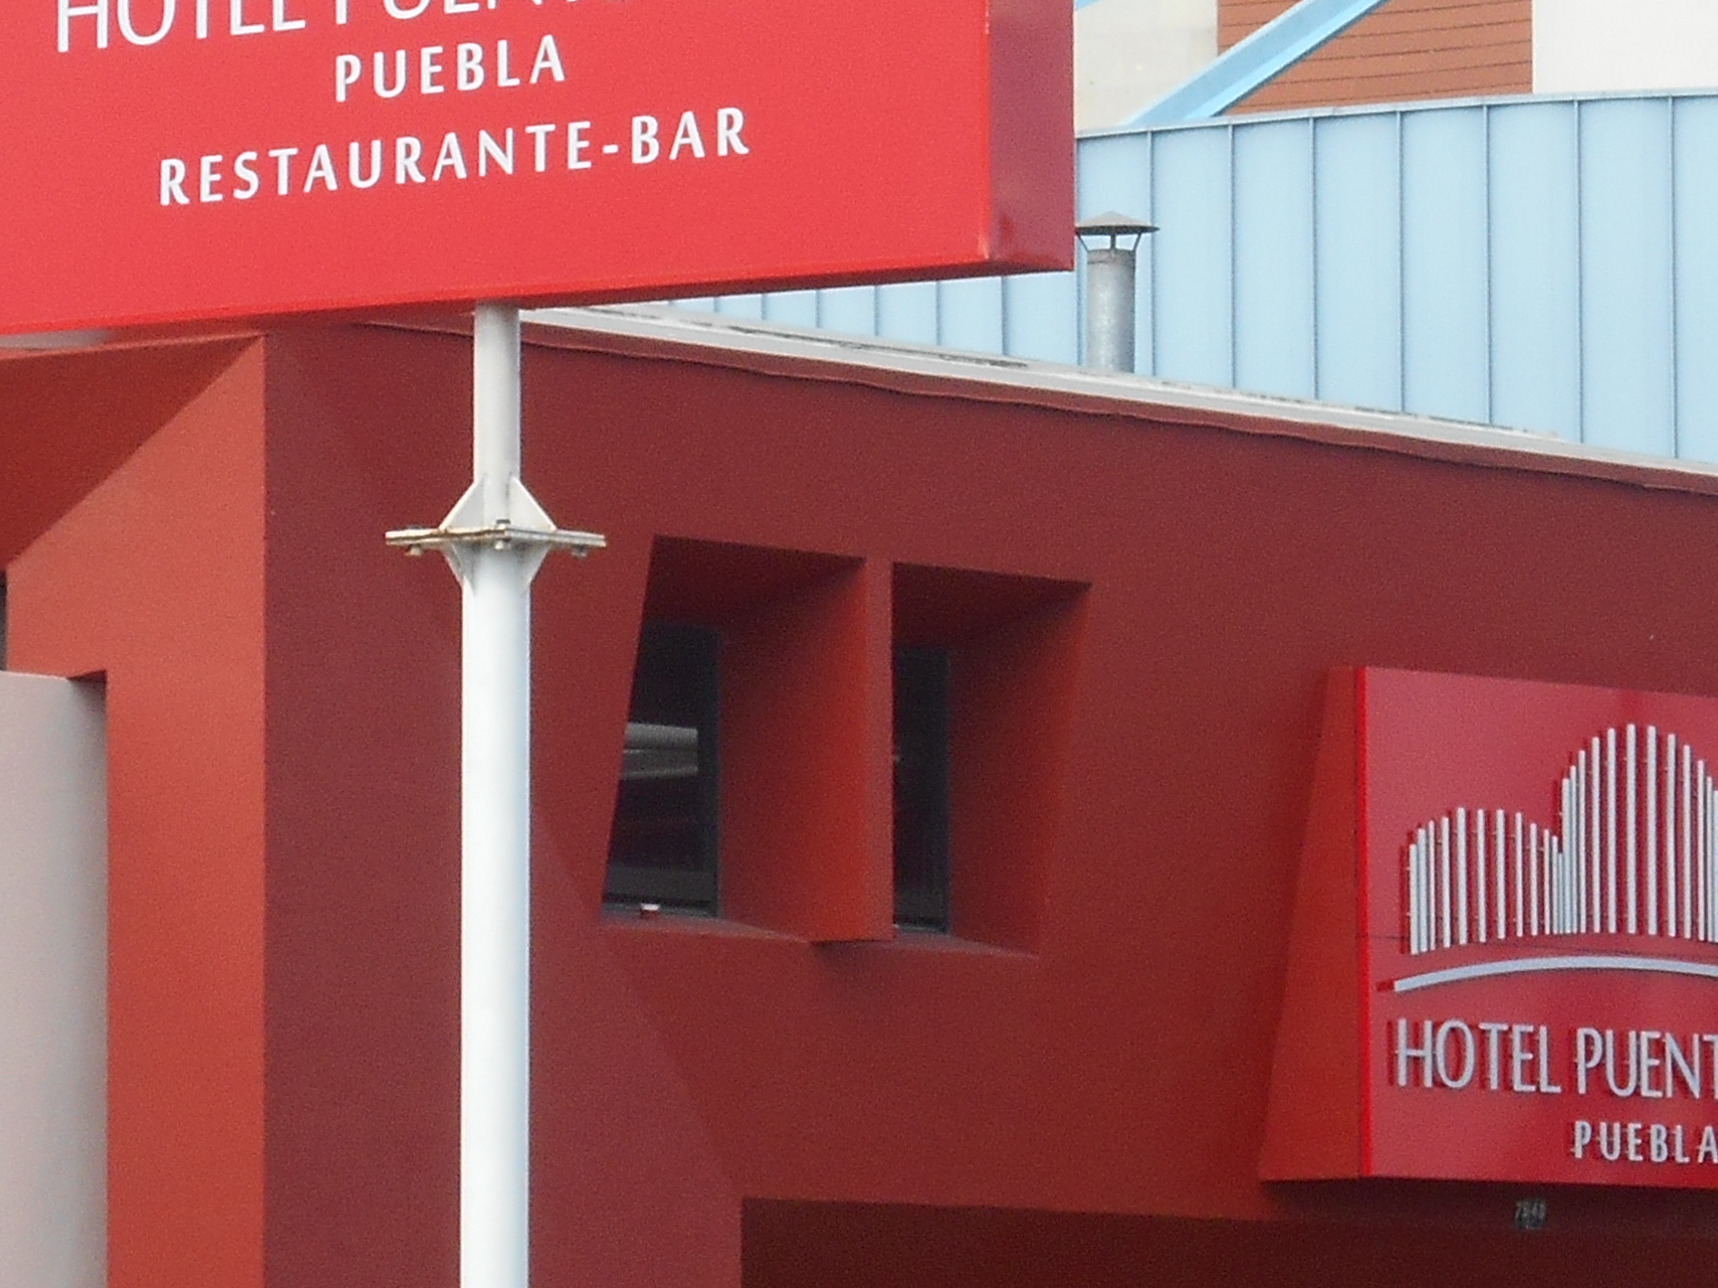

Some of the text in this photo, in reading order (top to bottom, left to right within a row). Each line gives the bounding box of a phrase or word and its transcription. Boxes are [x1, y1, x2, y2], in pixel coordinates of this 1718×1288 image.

[334, 33, 567, 103] PUEBLA
[159, 105, 750, 207] RESTAURANTE-BAR
[1395, 1018, 1561, 1094] HOTEL
